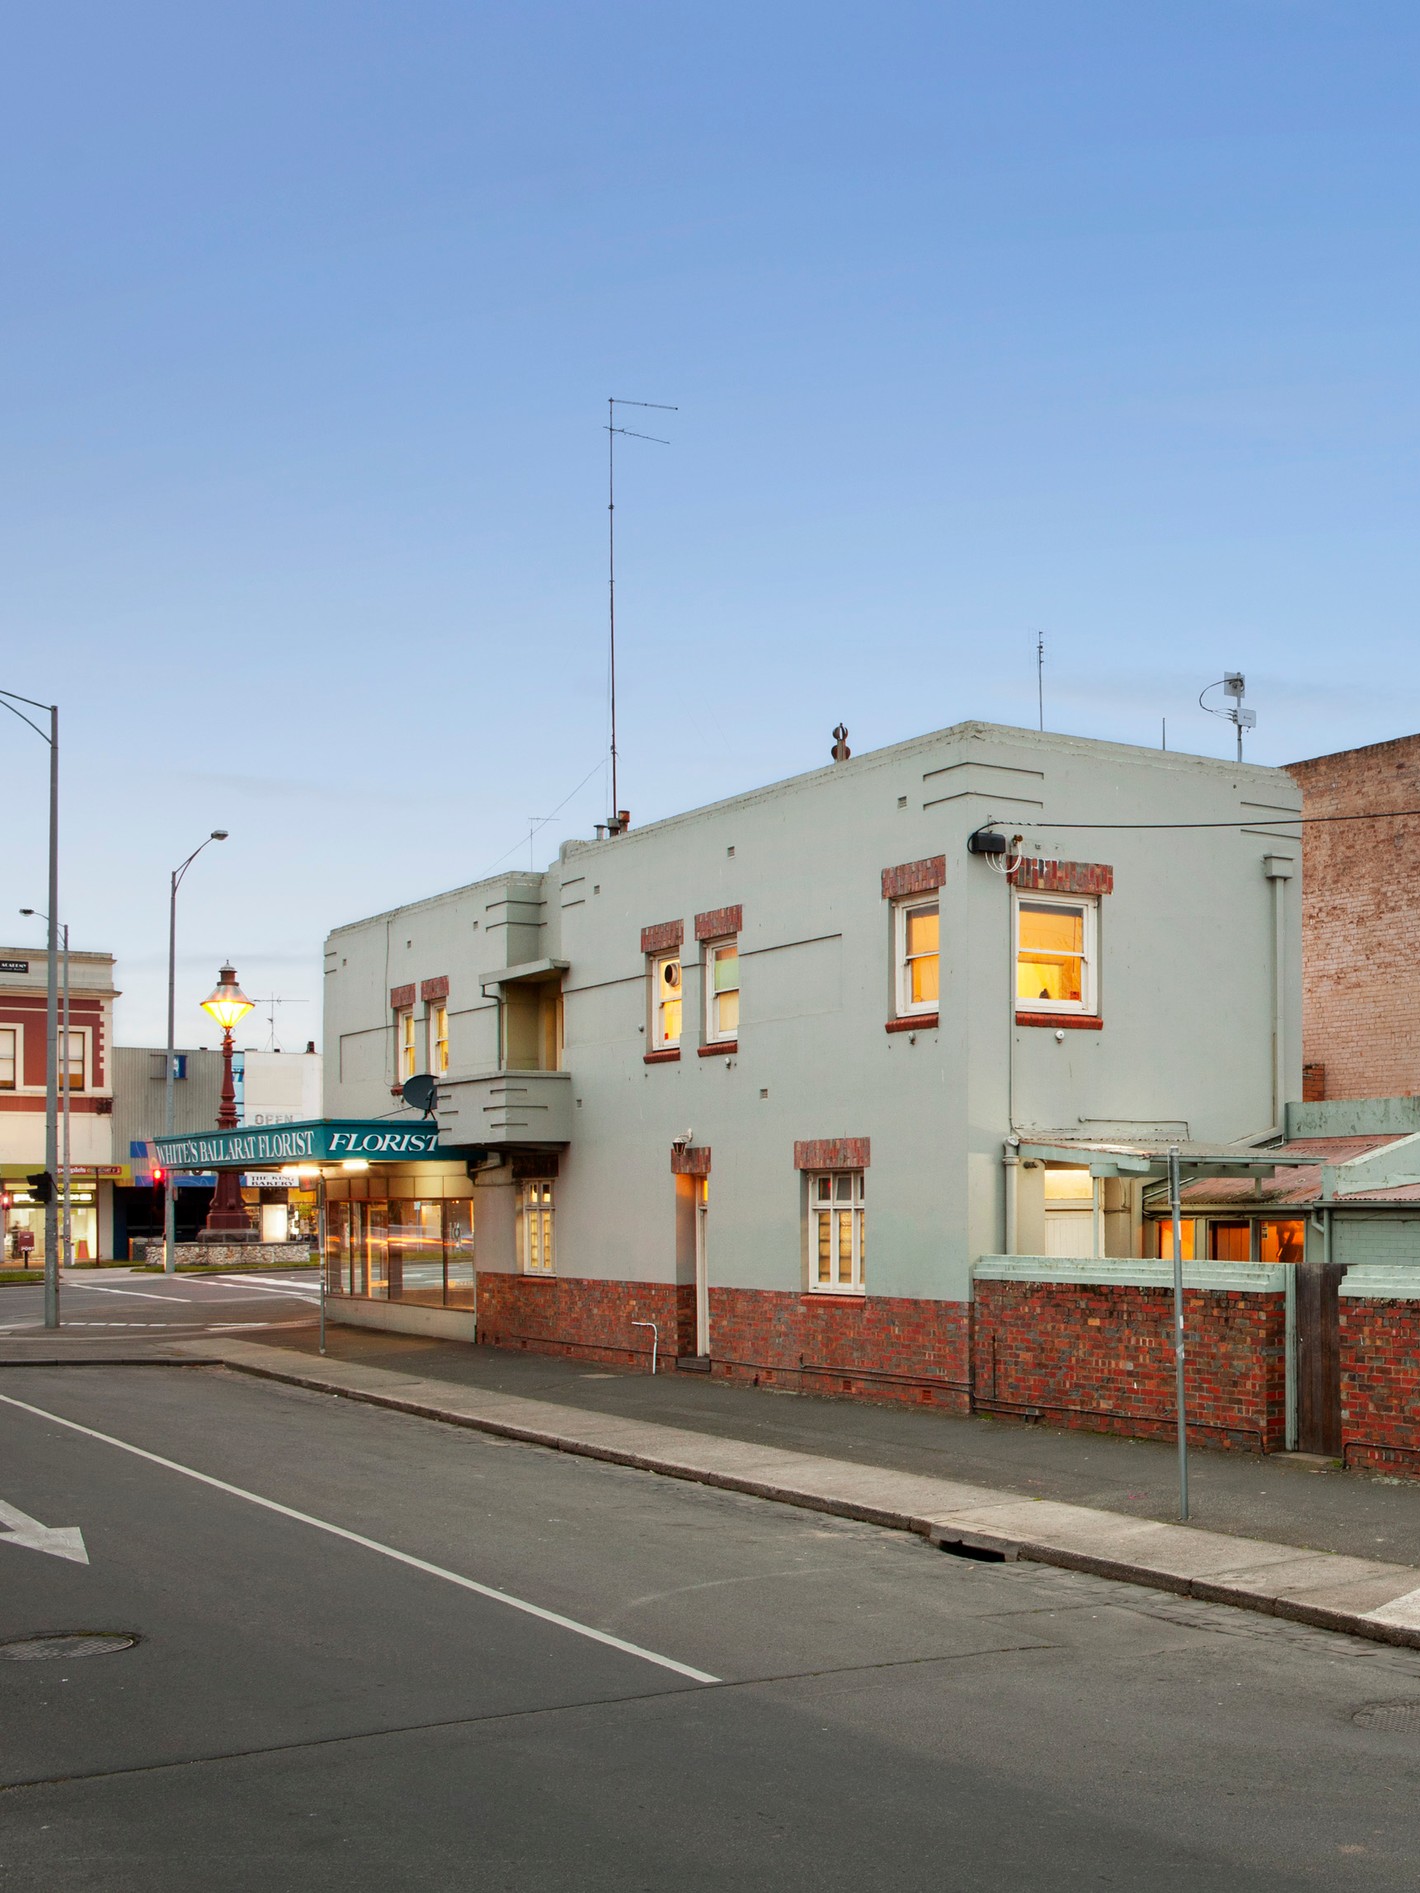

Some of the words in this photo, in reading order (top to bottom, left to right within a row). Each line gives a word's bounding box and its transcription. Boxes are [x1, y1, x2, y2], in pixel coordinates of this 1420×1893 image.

[156, 1140, 199, 1165] WHITE'S
[199, 1136, 256, 1163] BALLARAT
[257, 1130, 315, 1159] FLORIST
[328, 1133, 438, 1152] FLORIST
